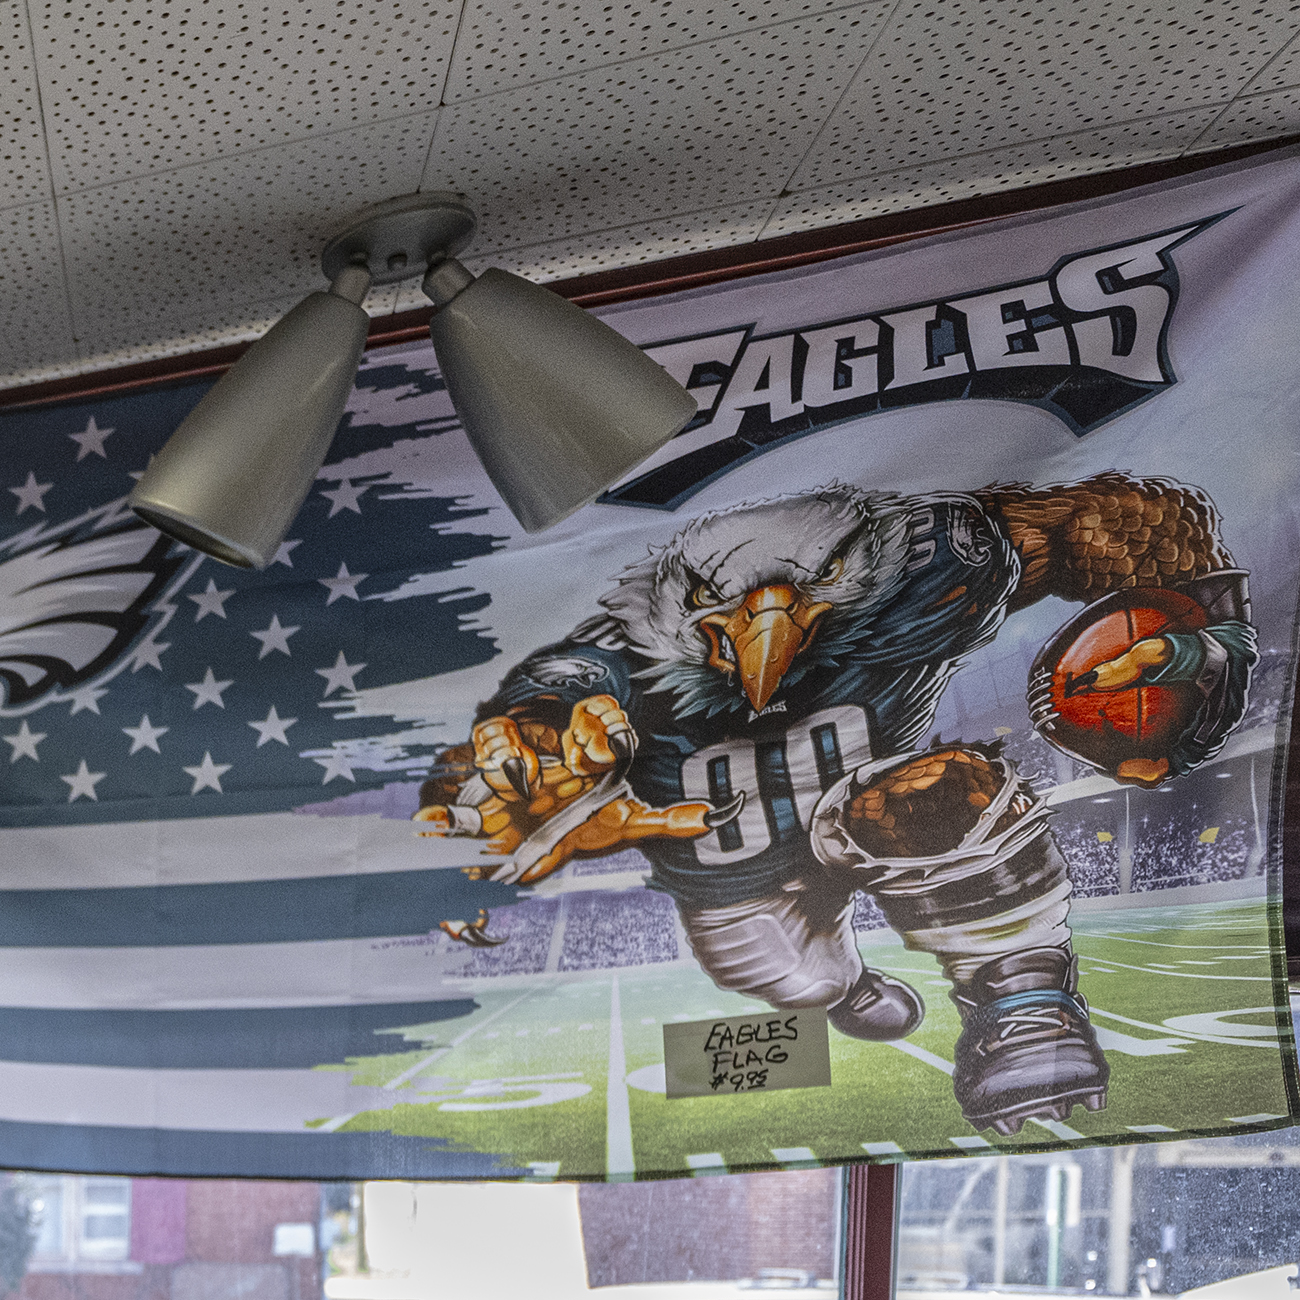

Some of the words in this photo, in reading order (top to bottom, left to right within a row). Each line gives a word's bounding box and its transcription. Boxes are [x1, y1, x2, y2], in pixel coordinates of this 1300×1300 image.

[652, 206, 1245, 432] EAGLES
[704, 1016, 797, 1052] EAGLES
[712, 1045, 789, 1073] FLAG
